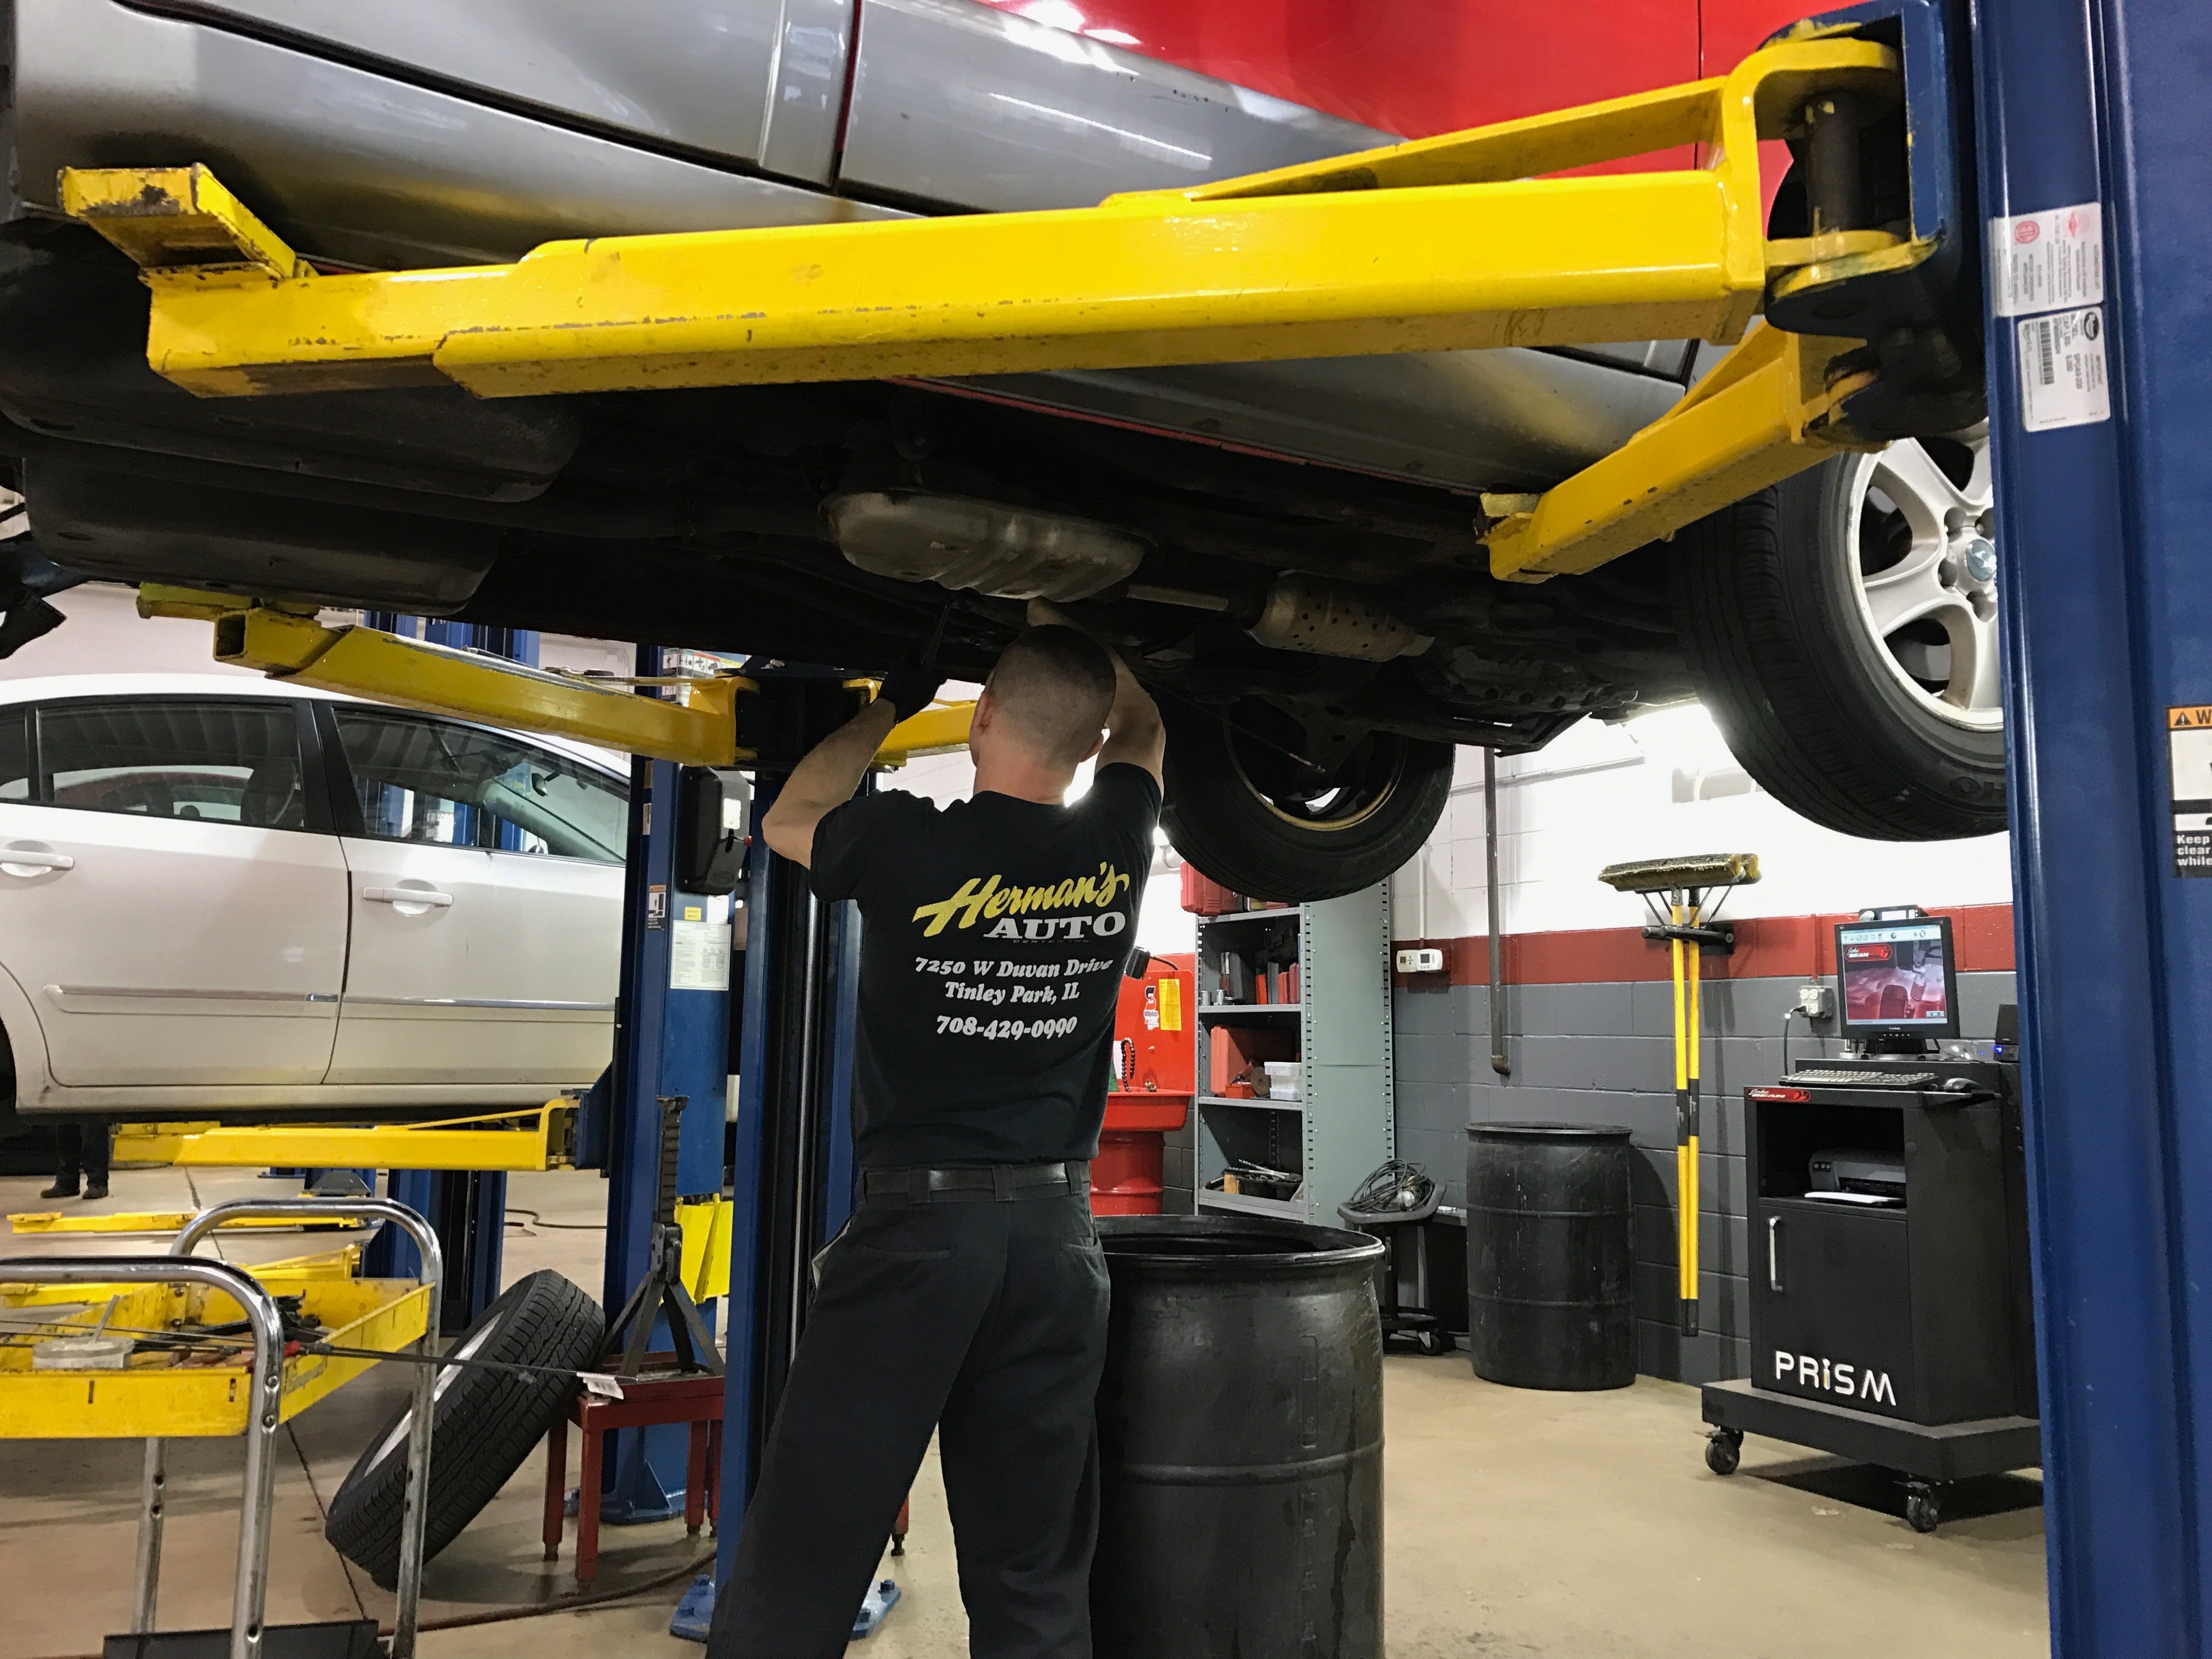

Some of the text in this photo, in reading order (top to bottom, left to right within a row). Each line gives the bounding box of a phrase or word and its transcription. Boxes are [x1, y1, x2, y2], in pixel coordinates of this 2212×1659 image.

[2177, 834, 2210, 845] Keep
[2177, 845, 2211, 855] clear
[911, 861, 1130, 938] Herman's
[983, 911, 1126, 940] AUTO
[915, 957, 1114, 978] 7250 W Duvan Drive
[945, 981, 1081, 1006] Tinley Park, IL
[936, 1015, 1078, 1041] 708-429-0990
